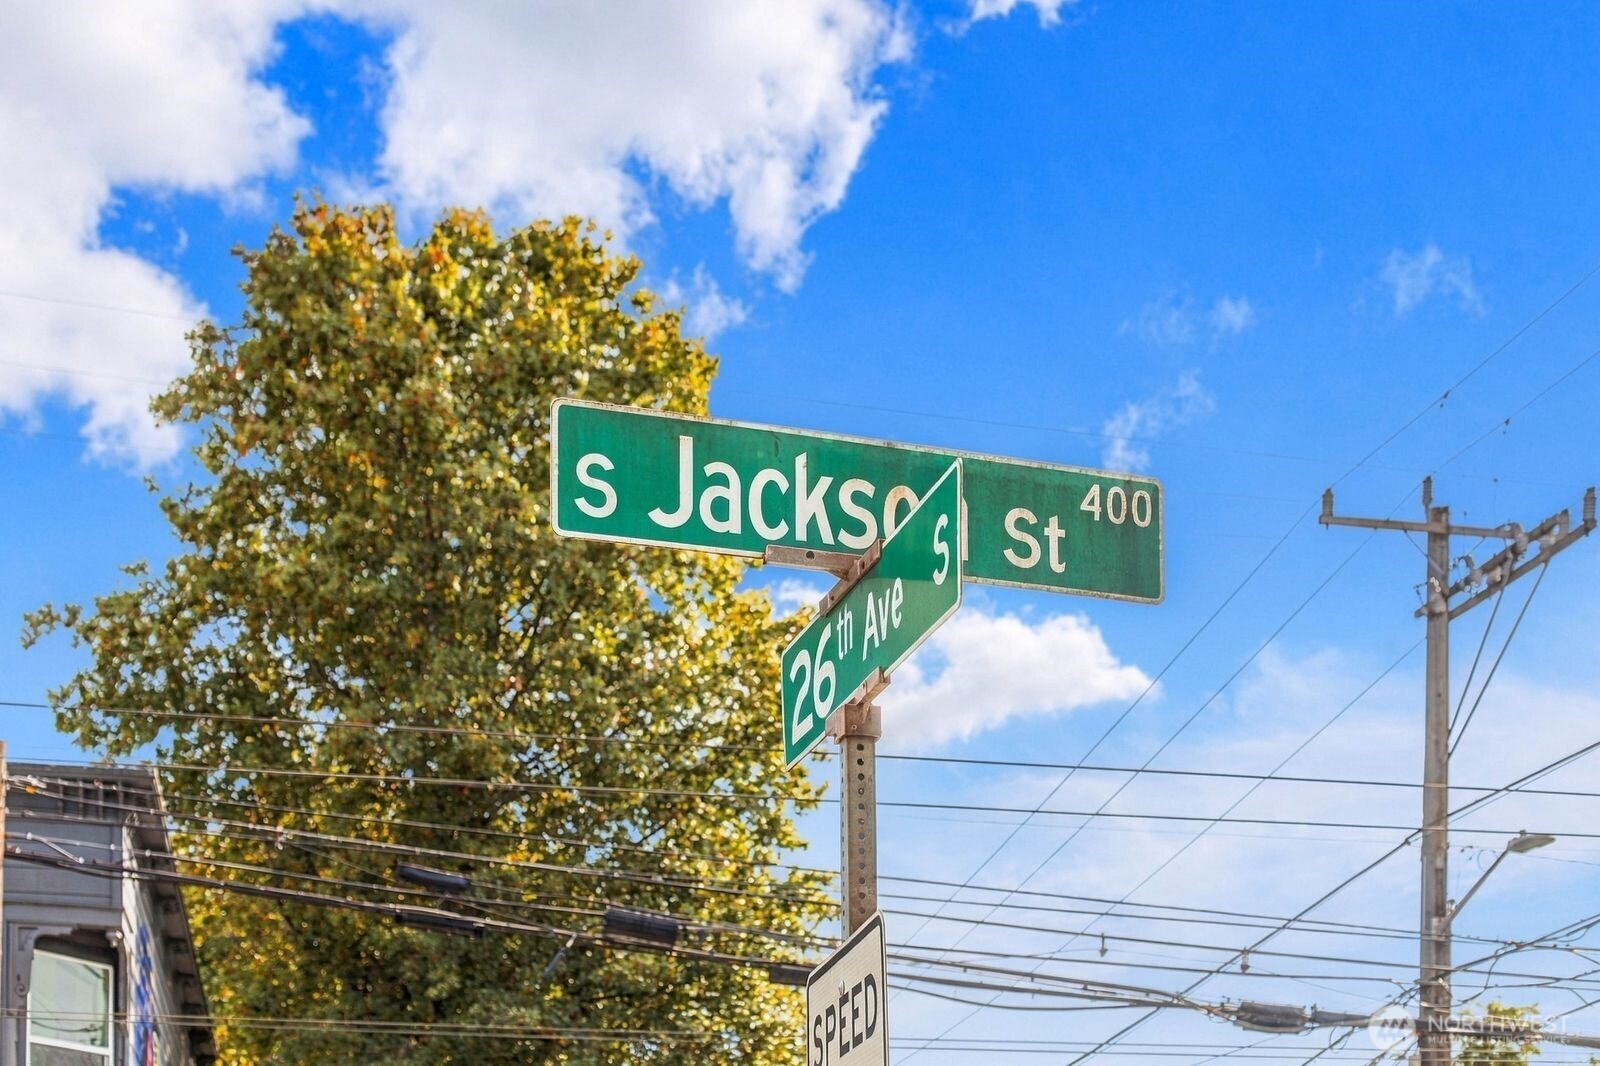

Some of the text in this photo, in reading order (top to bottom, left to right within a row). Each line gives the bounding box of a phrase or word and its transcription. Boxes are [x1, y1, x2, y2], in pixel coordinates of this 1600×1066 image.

[574, 452, 618, 518] S
[1003, 507, 1067, 574] St
[1080, 484, 1152, 528] 400
[789, 513, 950, 746] 26th Ave S
[813, 973, 878, 1066] SPEED
